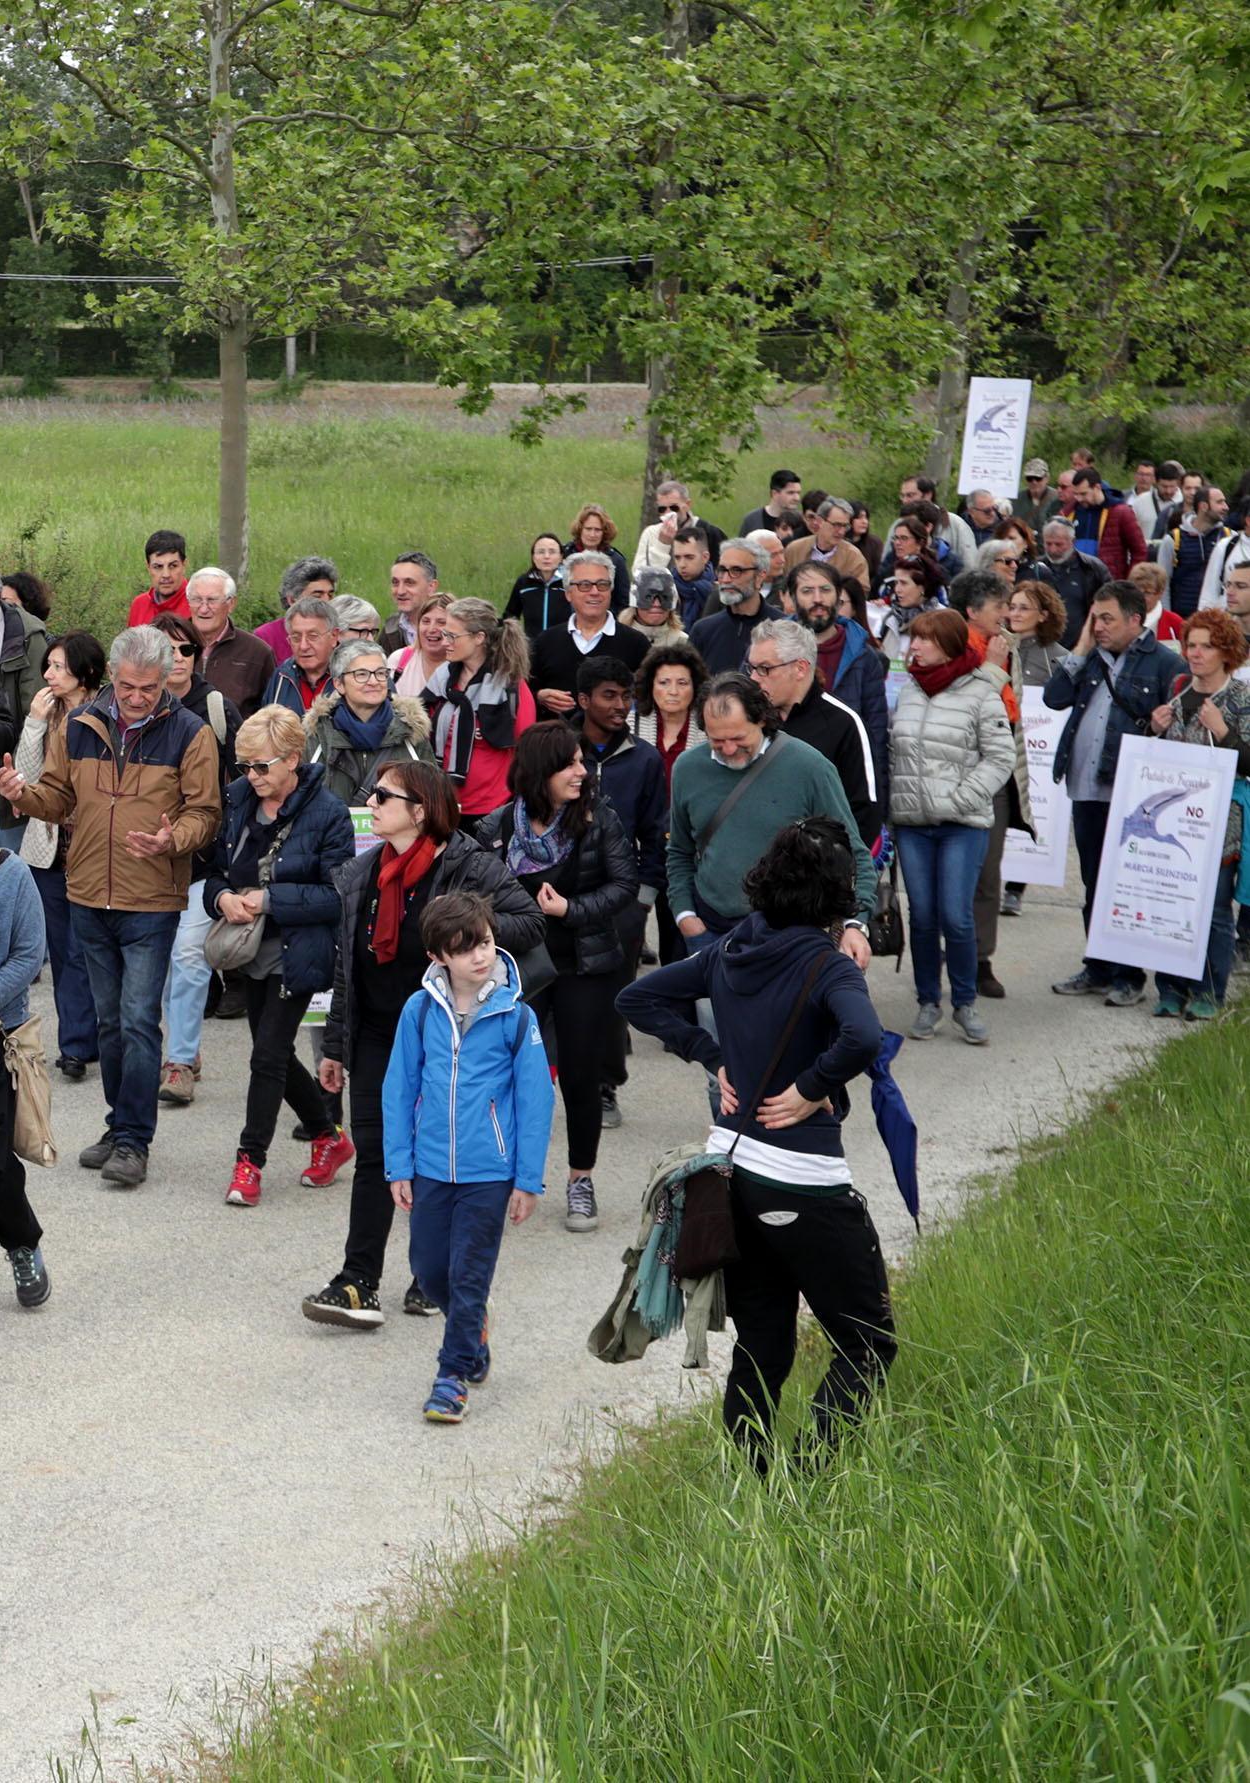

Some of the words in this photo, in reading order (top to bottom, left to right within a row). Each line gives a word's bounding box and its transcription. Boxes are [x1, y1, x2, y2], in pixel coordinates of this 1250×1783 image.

[1027, 739, 1048, 749] NO
[1186, 806, 1204, 818] NO
[1124, 862, 1154, 875] MARCIA
[1155, 866, 1198, 883] SILENZIOSA
